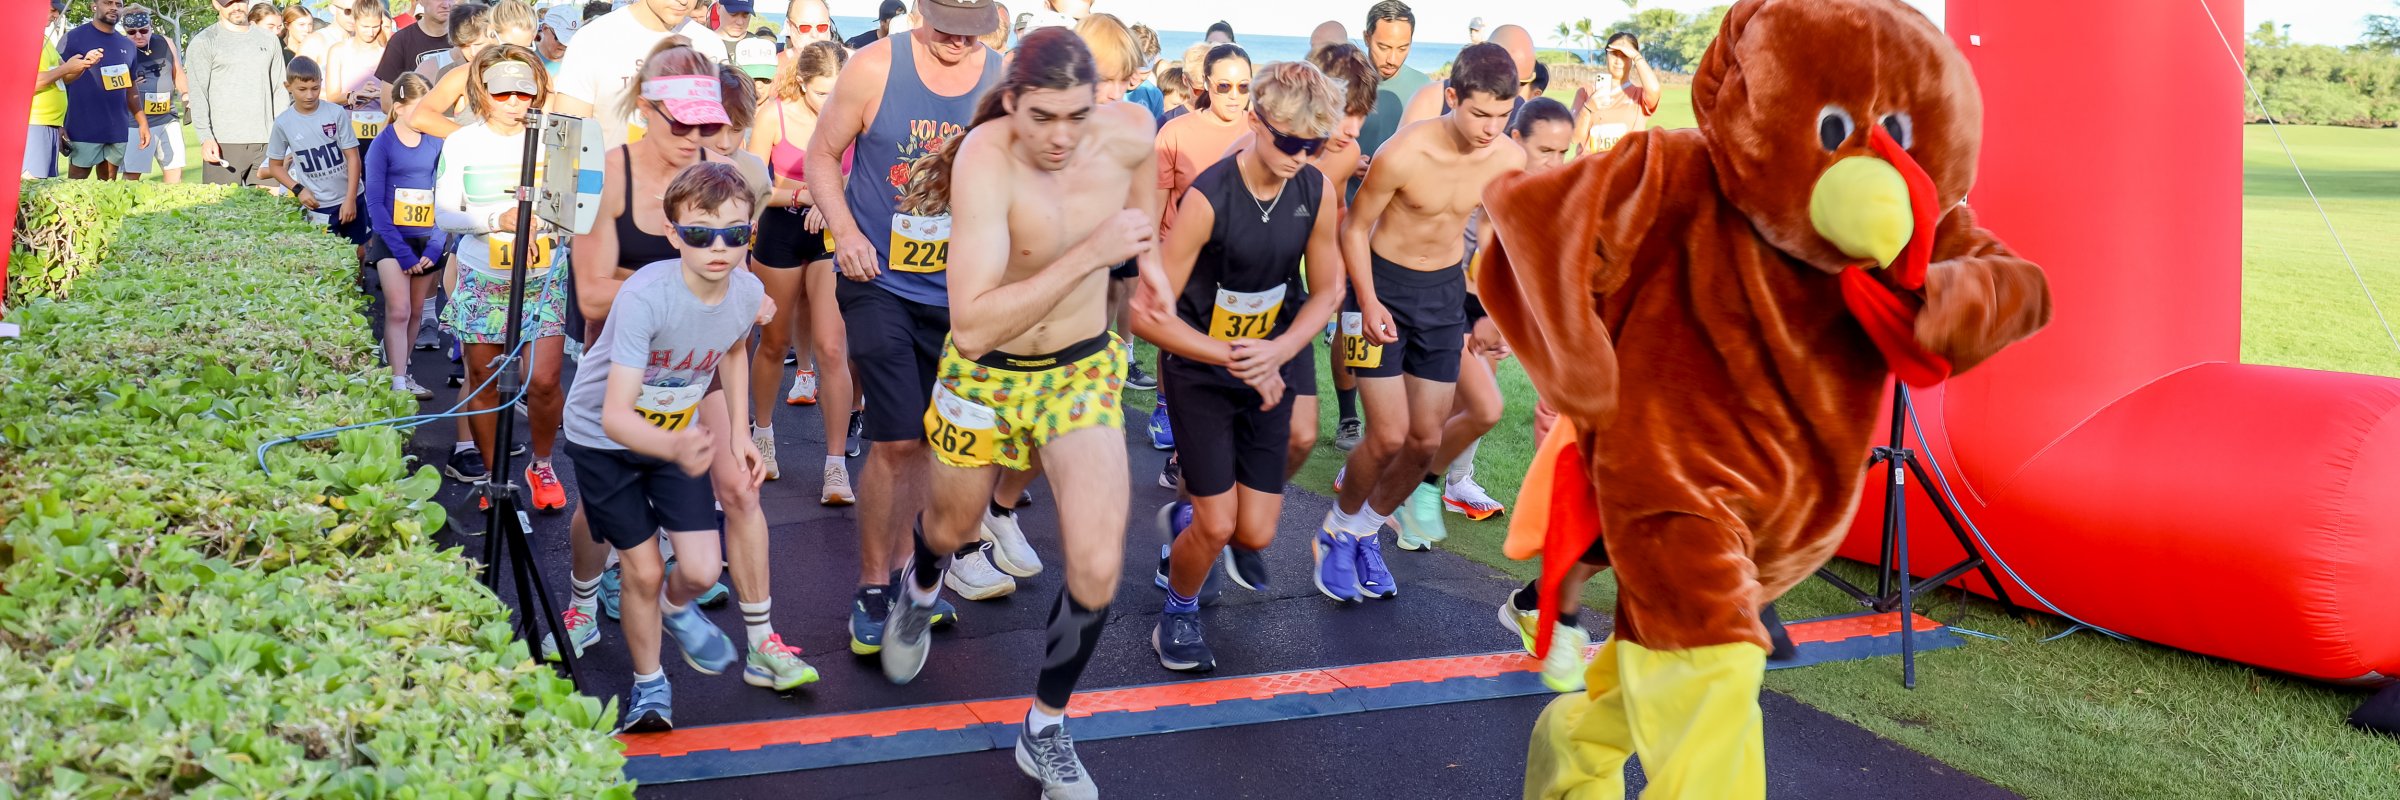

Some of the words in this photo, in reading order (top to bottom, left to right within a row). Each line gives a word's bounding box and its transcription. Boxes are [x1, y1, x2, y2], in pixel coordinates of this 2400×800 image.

[111, 75, 125, 87] 50
[150, 102, 168, 113] 259
[361, 123, 378, 137] 80
[910, 119, 965, 141] VOLCO
[295, 140, 344, 173] JMD
[403, 205, 431, 223] 387
[903, 241, 949, 267] 224
[1225, 312, 1269, 337] 371
[1343, 336, 1369, 361] 93
[930, 416, 977, 457] 262
